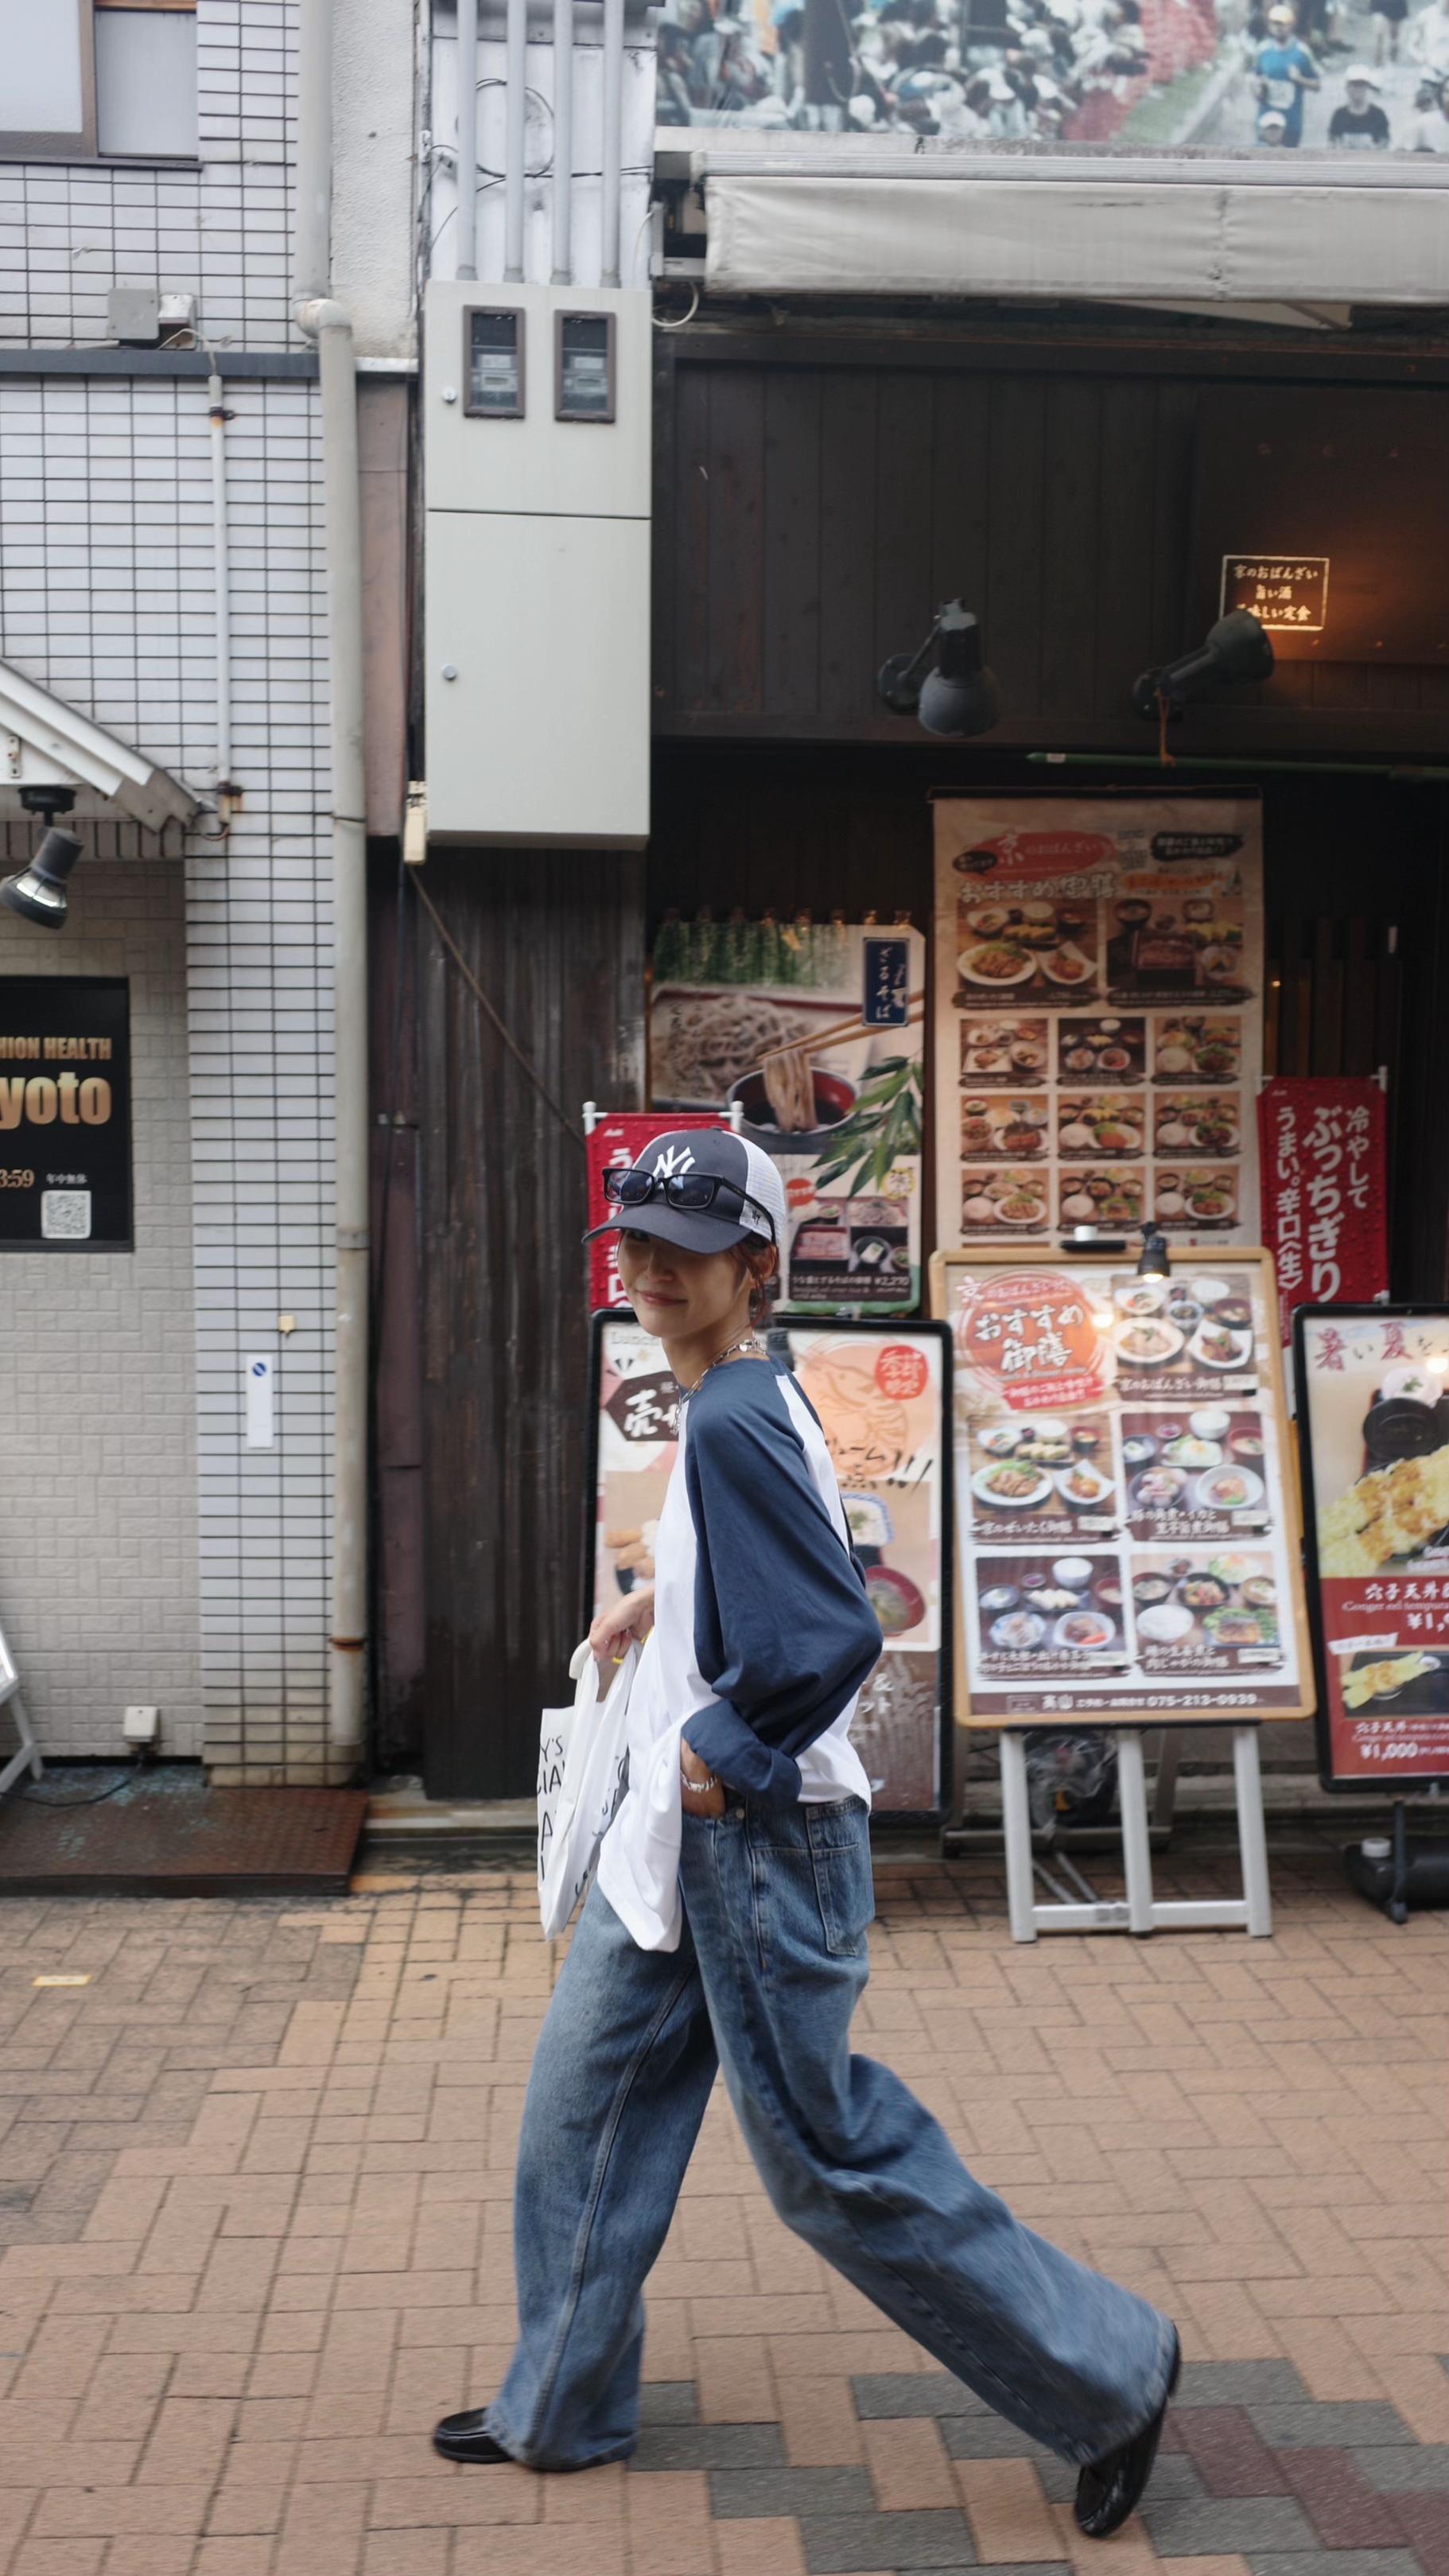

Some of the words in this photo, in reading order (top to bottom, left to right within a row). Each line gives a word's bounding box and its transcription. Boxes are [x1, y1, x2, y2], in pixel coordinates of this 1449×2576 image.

[43, 1037, 113, 1060] HEALTH
[1346, 1105, 1370, 1209] 冷やして
[1303, 1105, 1346, 1303] ぶっちぎり
[974, 1303, 1085, 1342] おすすめ
[1000, 1330, 1074, 1374] 御膳
